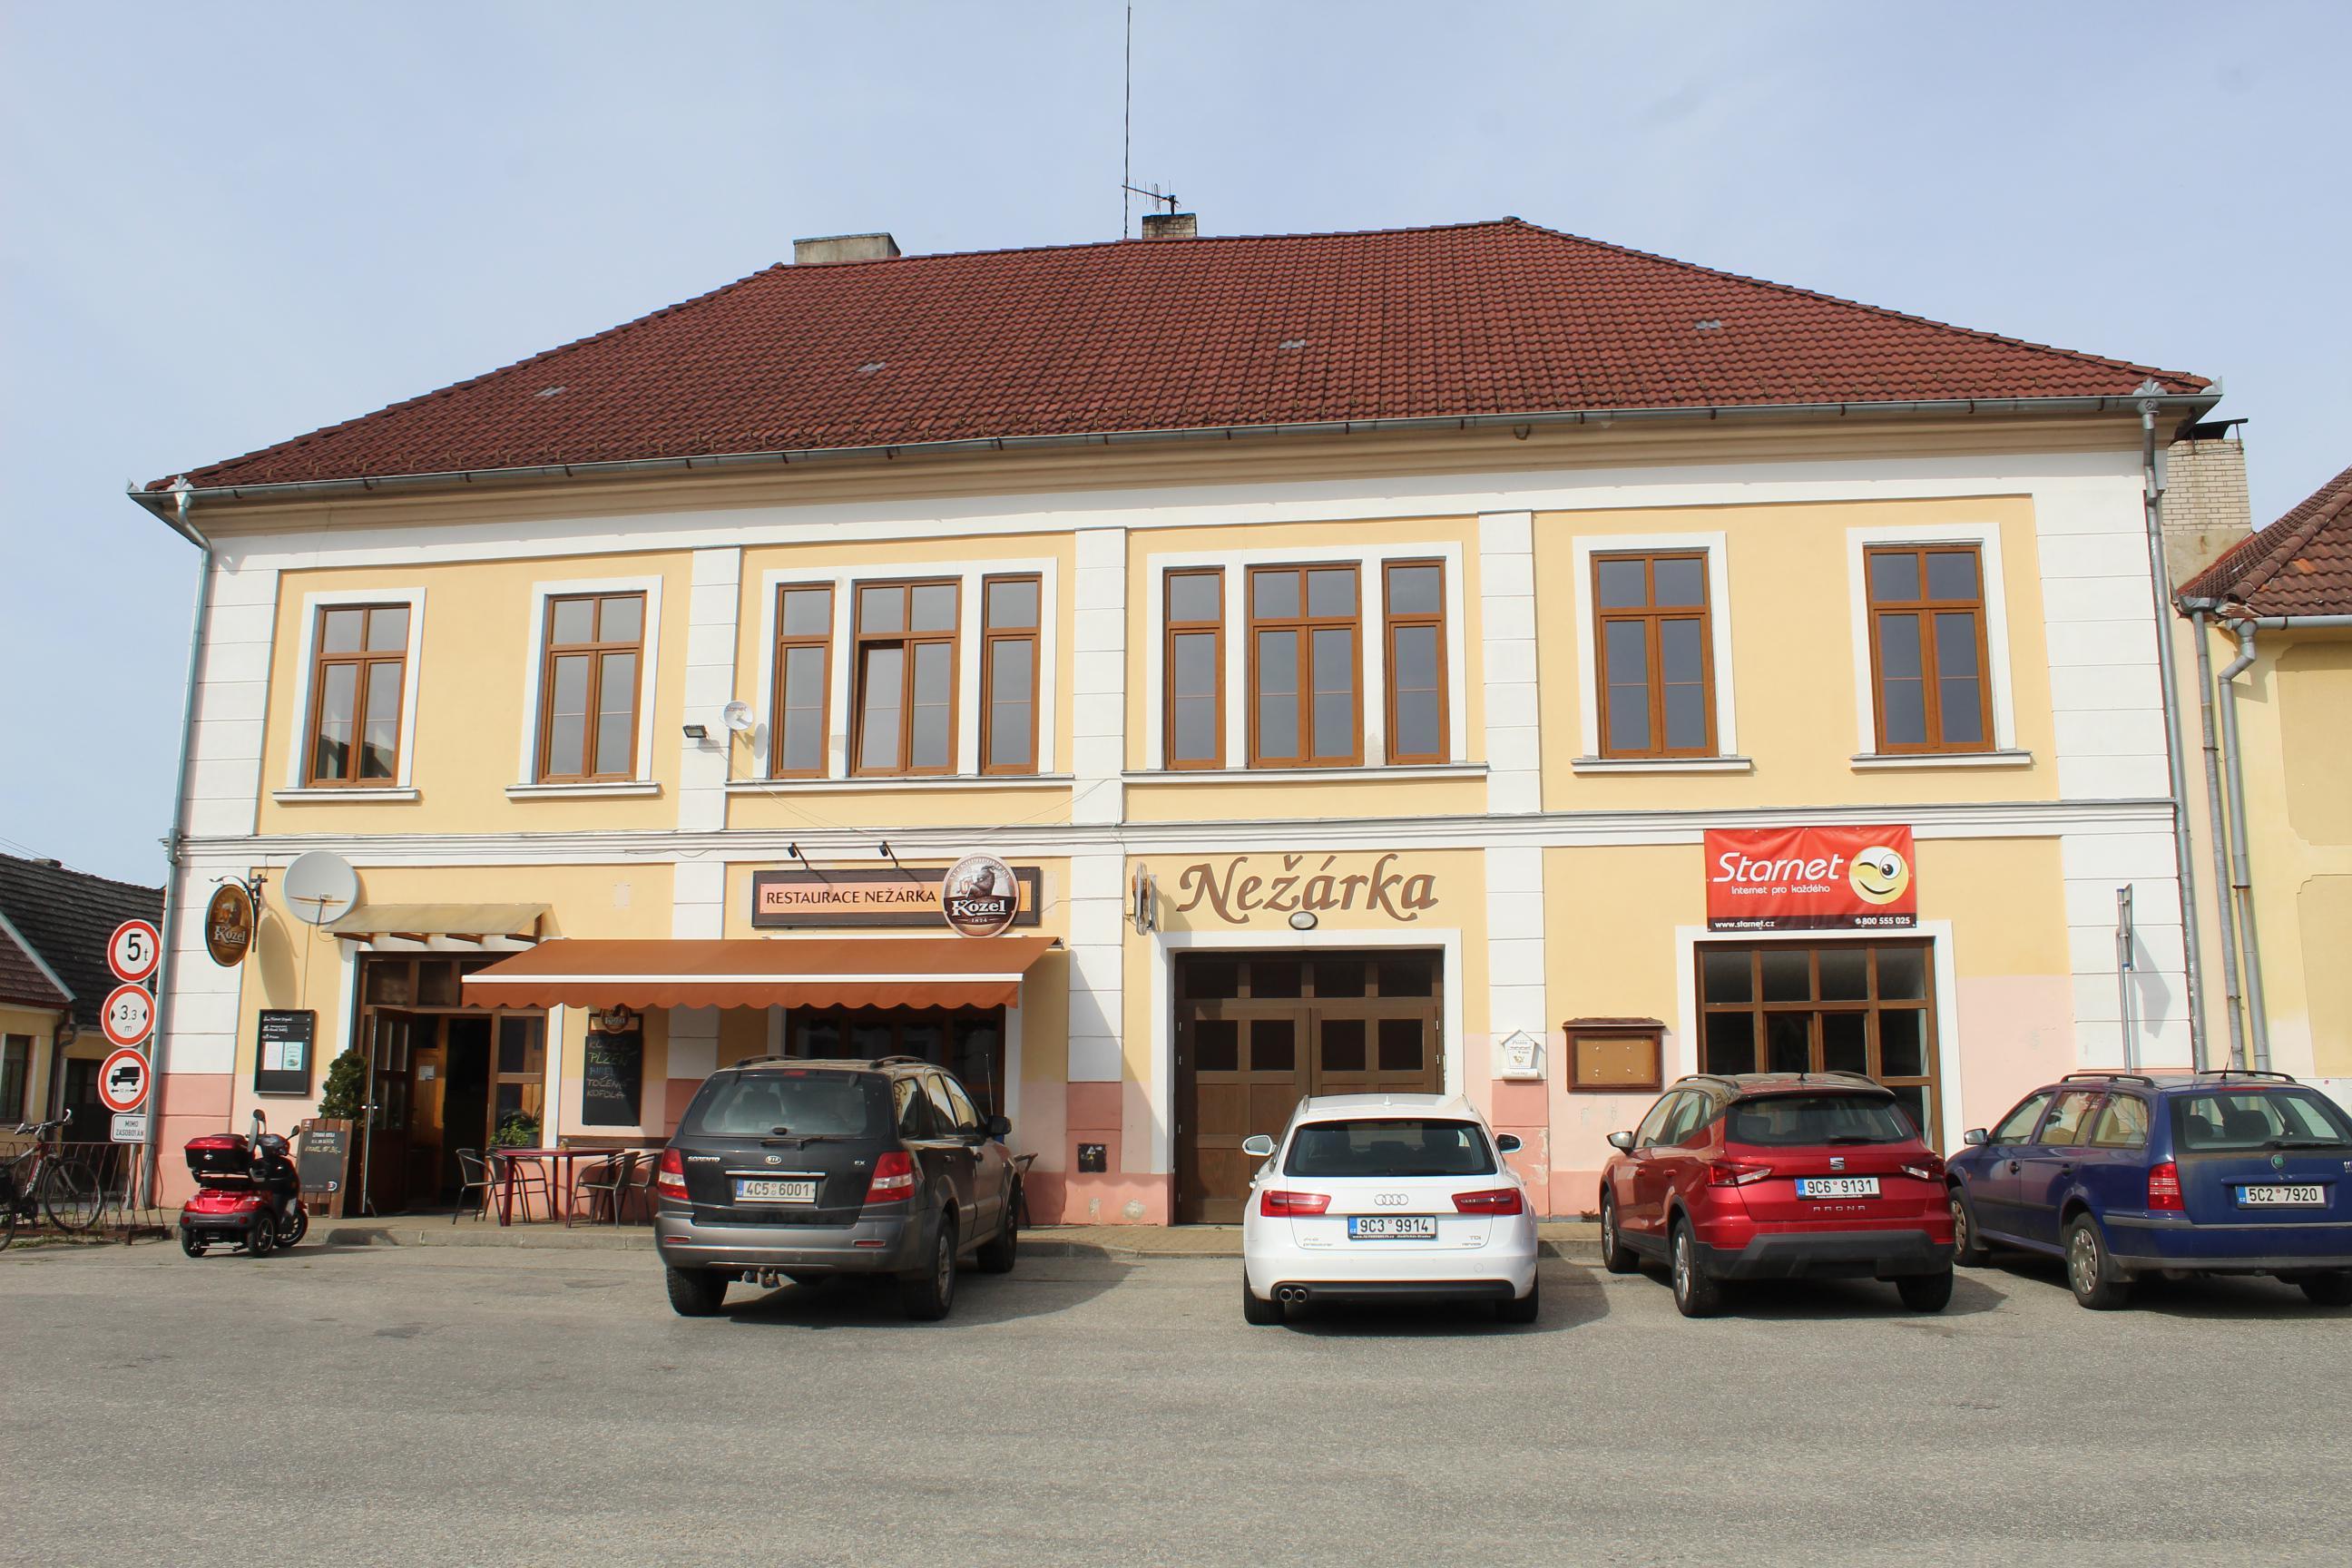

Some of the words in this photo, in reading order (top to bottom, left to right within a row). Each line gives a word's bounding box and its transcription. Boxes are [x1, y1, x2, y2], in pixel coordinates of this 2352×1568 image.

[1713, 852, 1844, 883] Starnet
[767, 890, 860, 905] RESTAURACE
[865, 887, 936, 903] NEŽÁRKA
[1176, 853, 1439, 924] Nežárka
[1731, 886, 1768, 895] Internet
[1771, 887, 1787, 896] pro
[1791, 885, 1830, 894] každého
[951, 899, 1006, 916] Kozel
[1715, 920, 1775, 928] www.starnet.cz
[1896, 916, 1910, 925] 025
[213, 925, 246, 944] Kozel
[127, 934, 142, 961] 5
[144, 948, 148, 961] t
[746, 1182, 769, 1196] 4C5
[779, 1181, 809, 1196] 6001
[1808, 1181, 1831, 1193] 9C6
[1841, 1180, 1873, 1192] 9131
[2249, 1188, 2274, 1201] 5C2
[2284, 1188, 2318, 1201] 7920
[1360, 1219, 1385, 1233] 9C3
[1395, 1219, 1428, 1233] 9914
